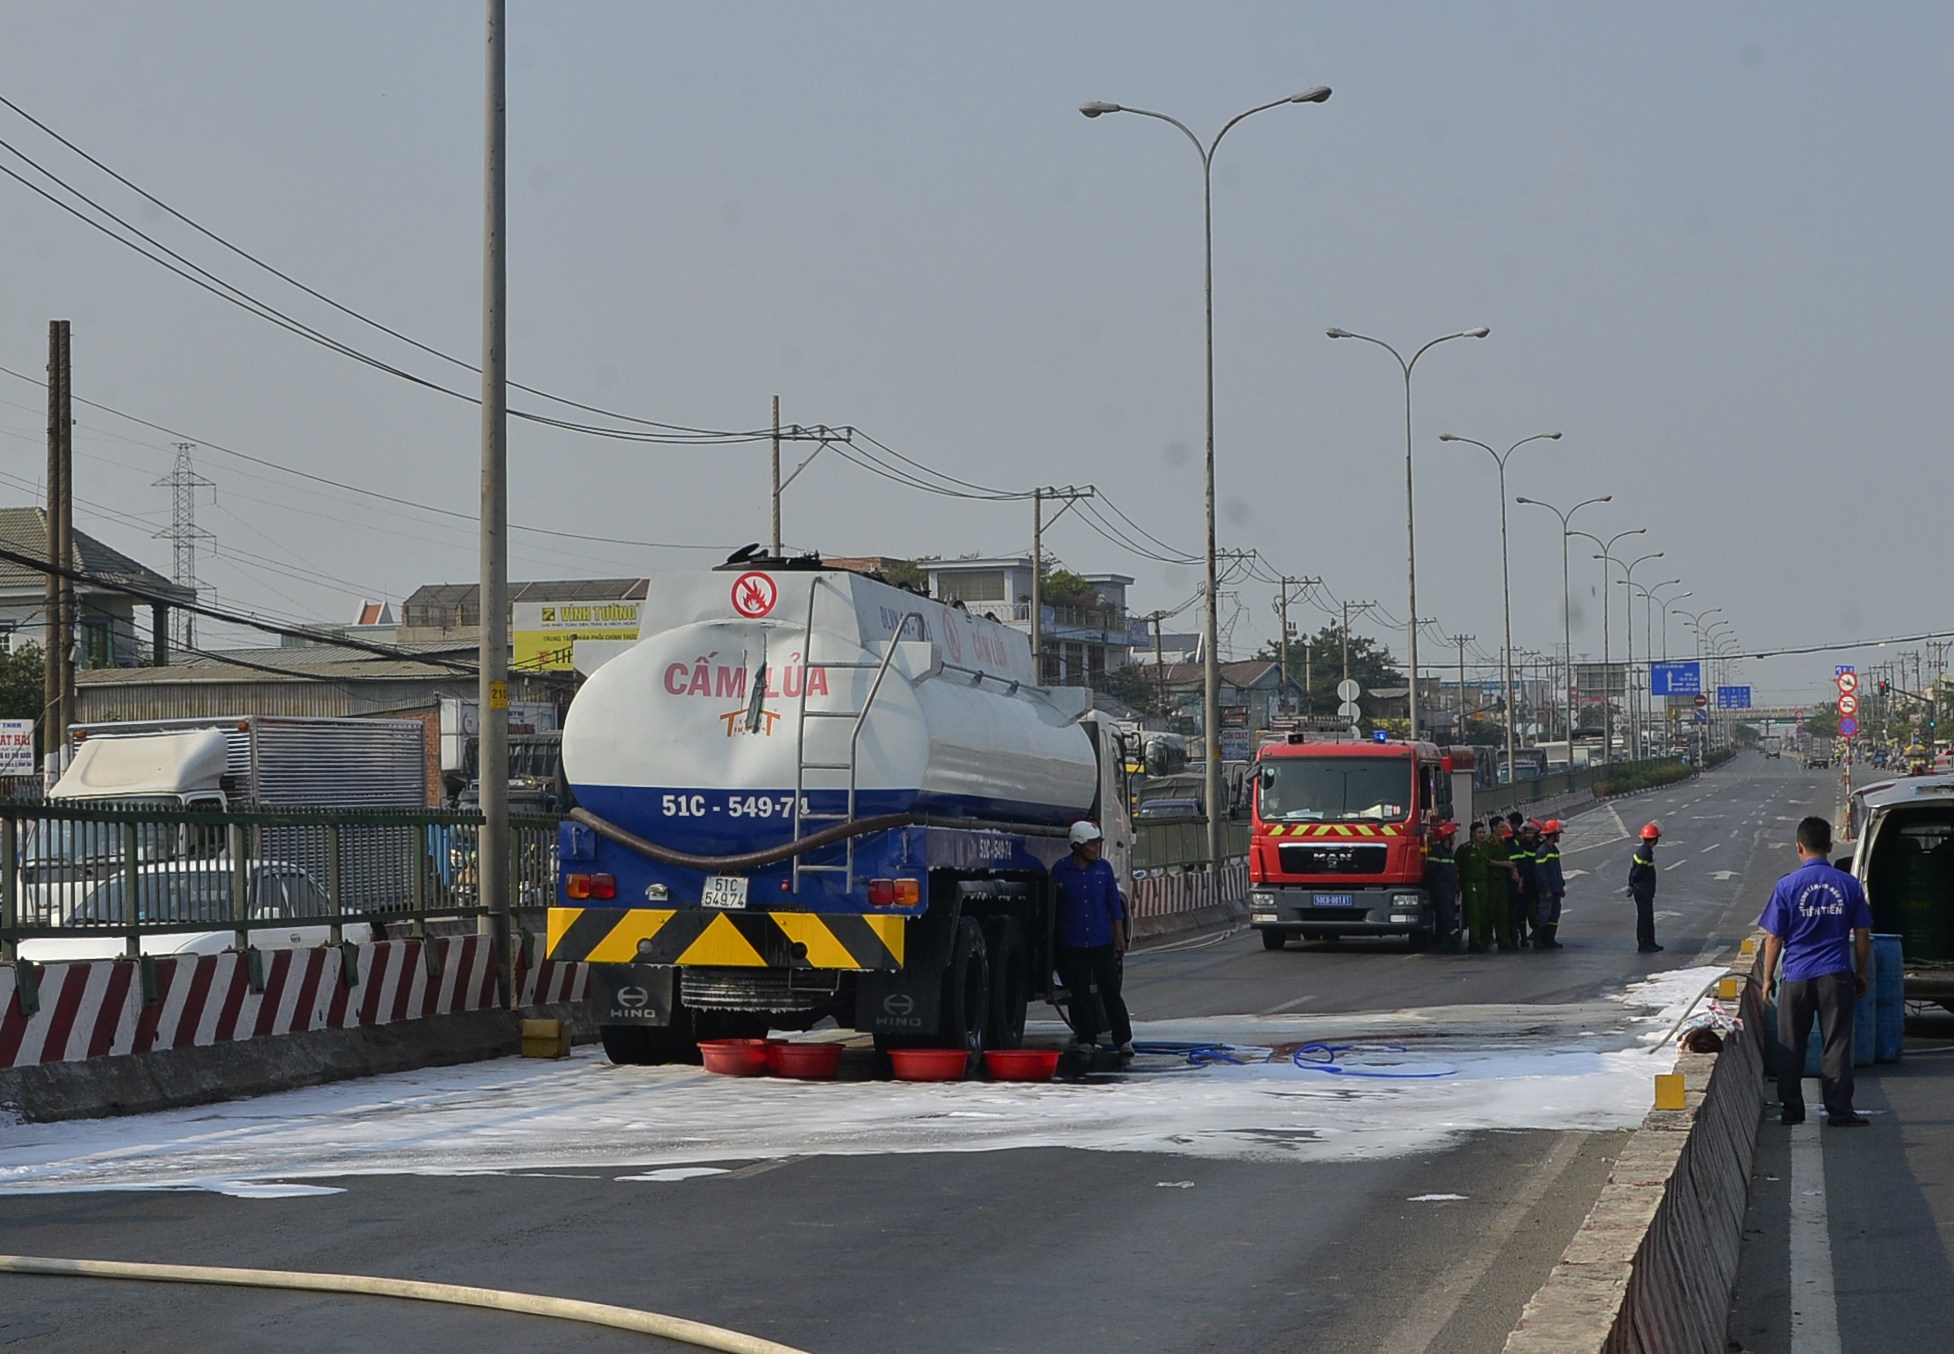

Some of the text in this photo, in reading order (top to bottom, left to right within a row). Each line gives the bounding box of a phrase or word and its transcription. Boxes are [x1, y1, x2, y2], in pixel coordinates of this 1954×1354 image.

[664, 651, 748, 699] CẤM
[662, 794, 706, 818] 51C
[1313, 853, 1353, 862] MAN
[715, 878, 739, 892] 51C
[610, 1009, 656, 1018] HINO
[876, 1016, 922, 1027] HINO
